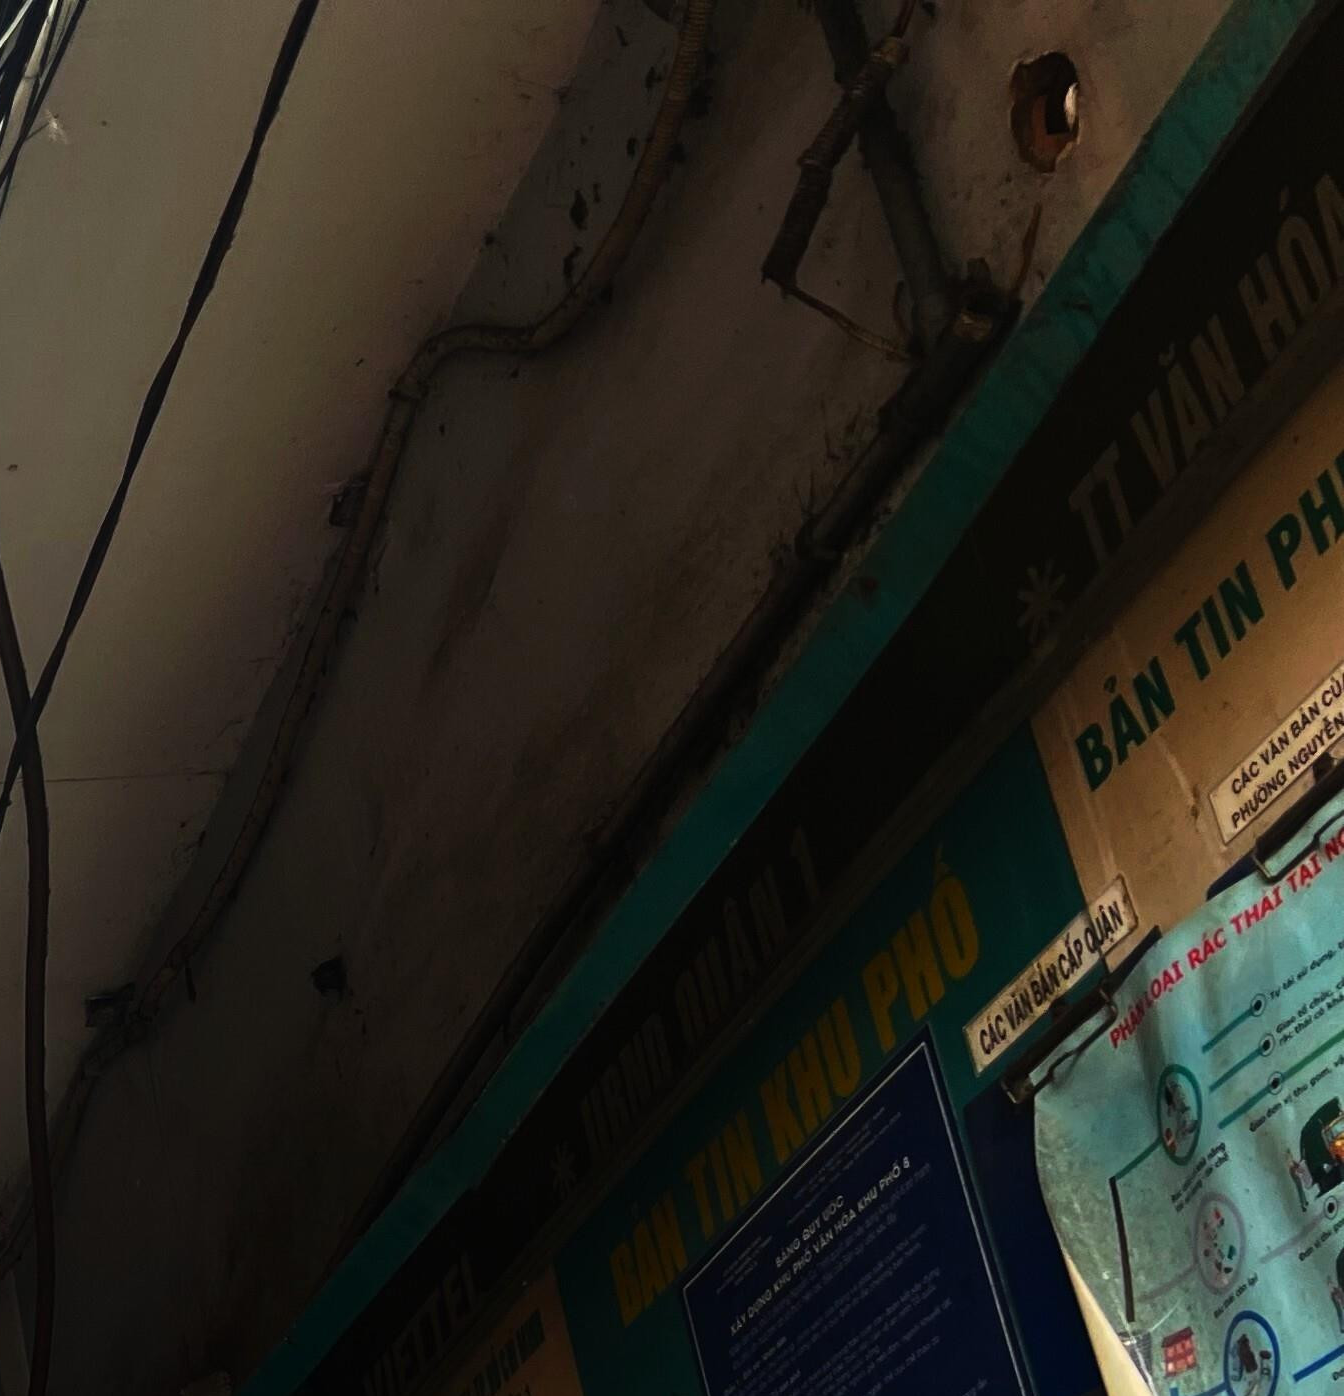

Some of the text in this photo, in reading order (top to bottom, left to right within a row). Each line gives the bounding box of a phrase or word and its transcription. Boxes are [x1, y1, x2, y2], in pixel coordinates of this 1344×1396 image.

[1068, 440, 1133, 569] TT
[1130, 313, 1245, 494] VĂN
[1075, 655, 1176, 792] BẢN
[1174, 560, 1265, 681] TIN
[1231, 672, 1344, 795] CÁC VĂN BẢN CỦ
[1231, 768, 1288, 829] PHƯỜNG
[979, 901, 1124, 1055] CÁC VĂN BẢN CẤP QUẬN
[1186, 926, 1228, 969] RÁC
[1286, 852, 1323, 893] TẠI
[680, 1108, 766, 1241] TIN
[757, 994, 863, 1166] KHU
[862, 843, 982, 1055] PHỐ
[857, 1185, 878, 1212] KHU
